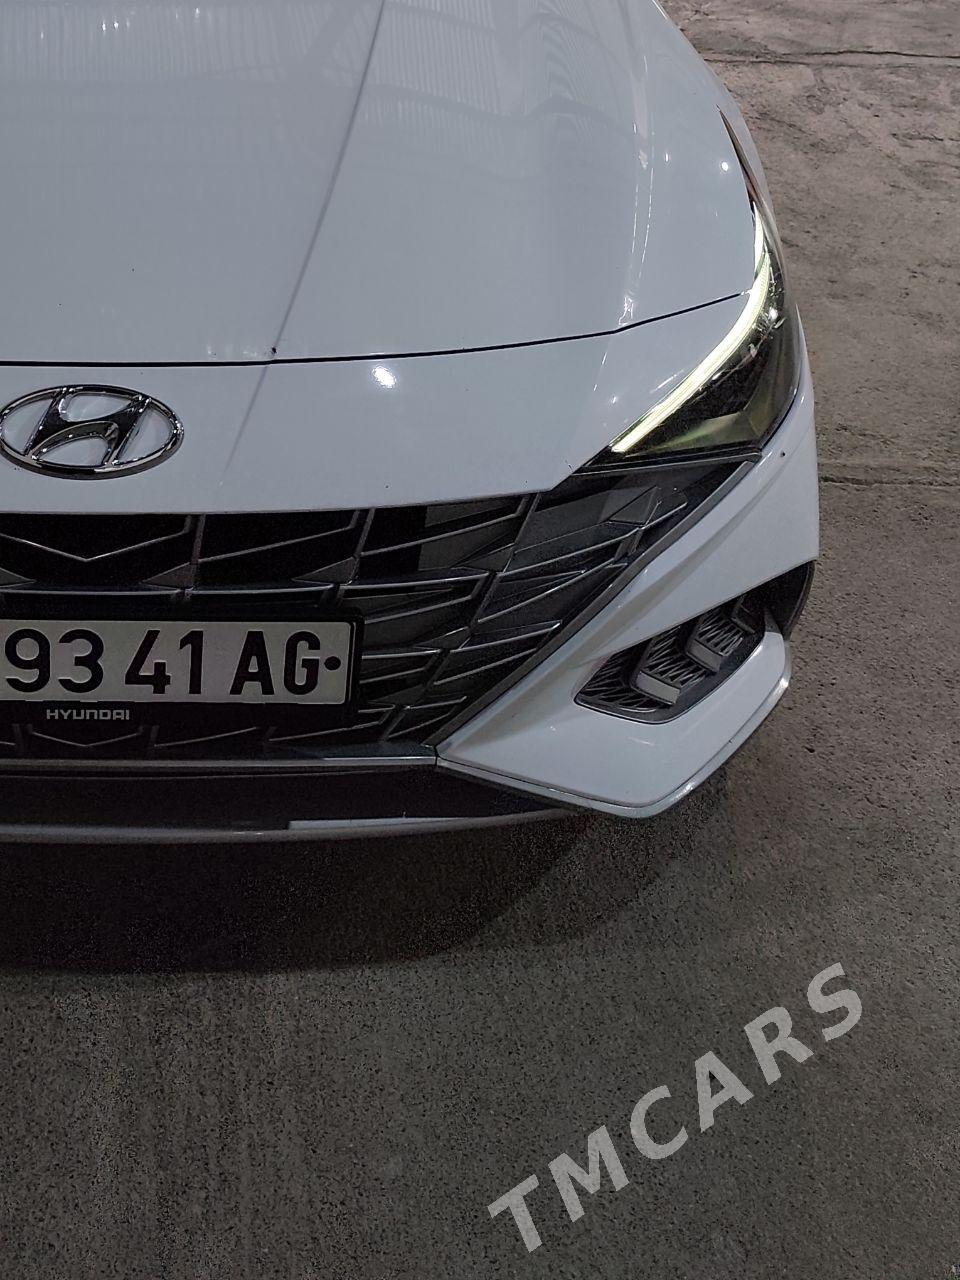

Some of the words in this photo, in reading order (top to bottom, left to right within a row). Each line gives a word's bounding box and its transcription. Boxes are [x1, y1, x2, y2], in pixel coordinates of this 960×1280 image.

[4, 628, 105, 694] 93
[124, 629, 204, 695] 41
[229, 630, 321, 696] AG
[46, 709, 130, 721] HYUNDAI
